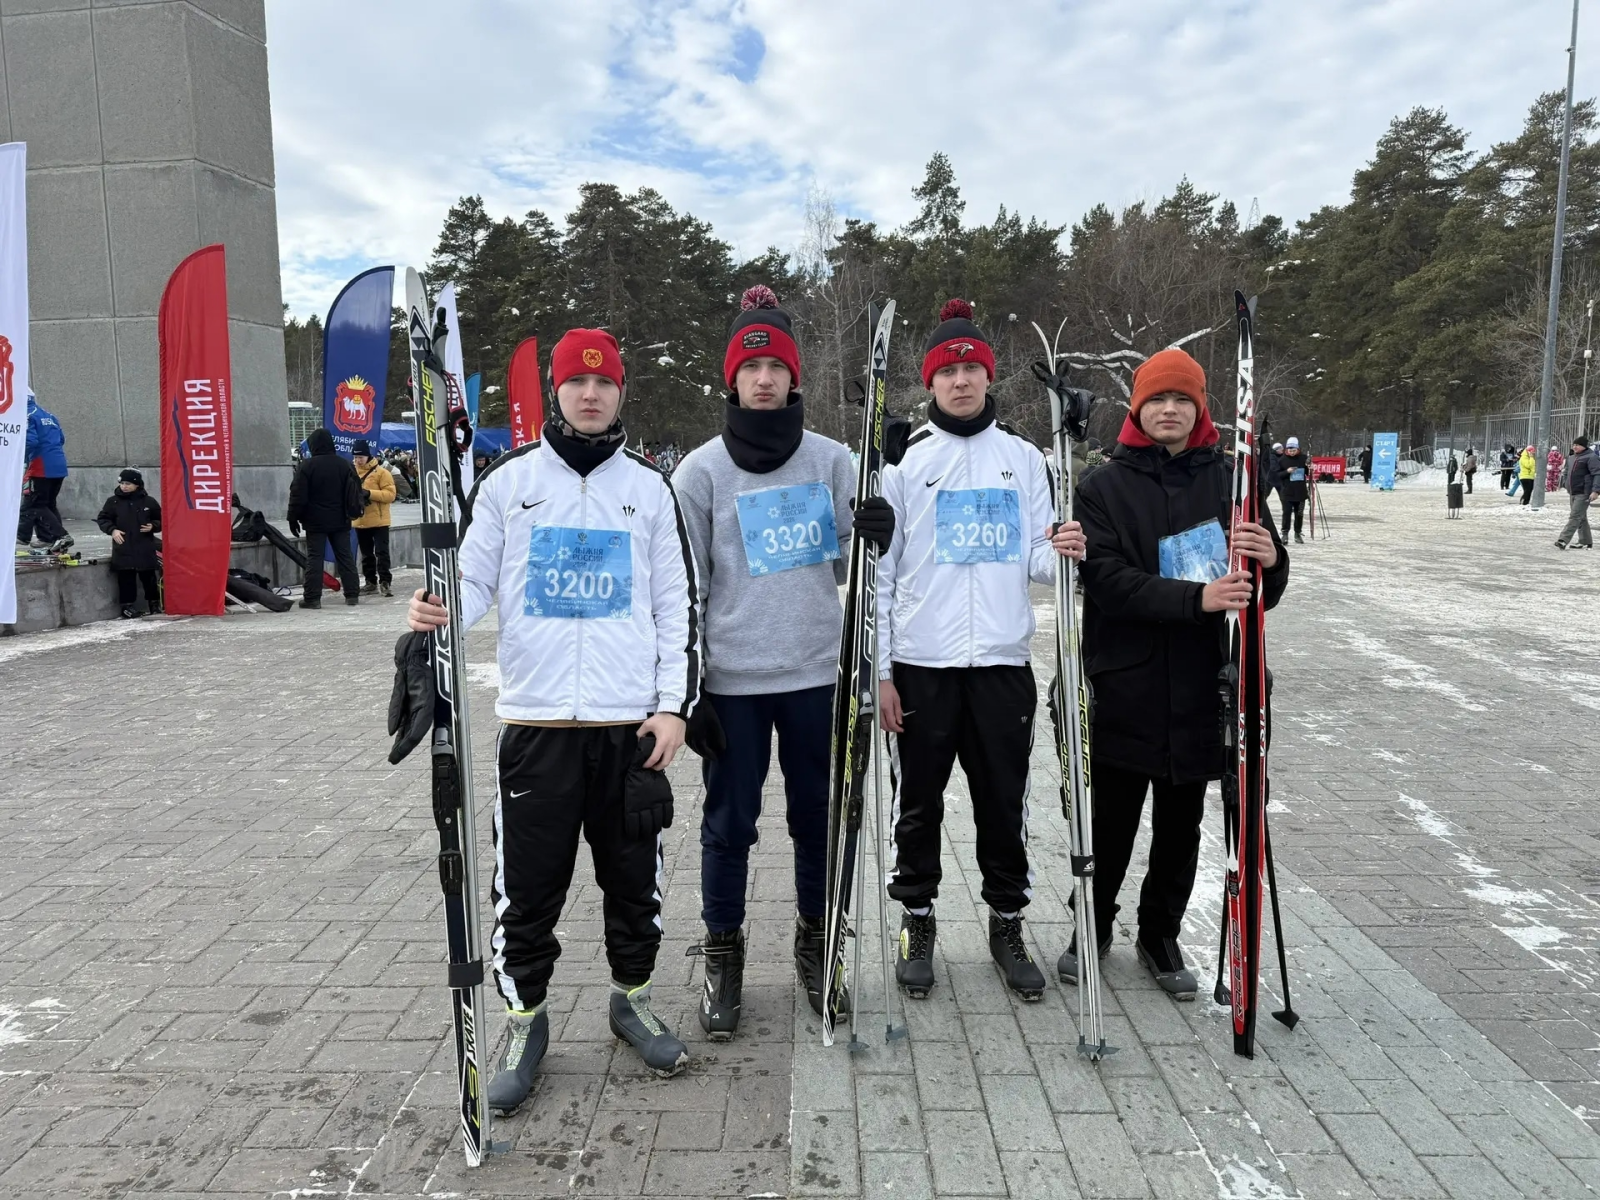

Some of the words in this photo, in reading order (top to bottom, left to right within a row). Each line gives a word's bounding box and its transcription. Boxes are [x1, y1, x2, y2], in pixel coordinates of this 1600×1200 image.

[873, 377, 885, 451] FISCHER
[183, 379, 225, 513] ДИРЕКЦИЯ
[572, 547, 604, 555] ЛЫЖНЯ
[762, 520, 823, 554] 3320
[952, 522, 1007, 547] 3260
[572, 554, 603, 562] РОССИИ
[544, 568, 614, 600] 3200
[463, 1008, 477, 1062] SKATE
